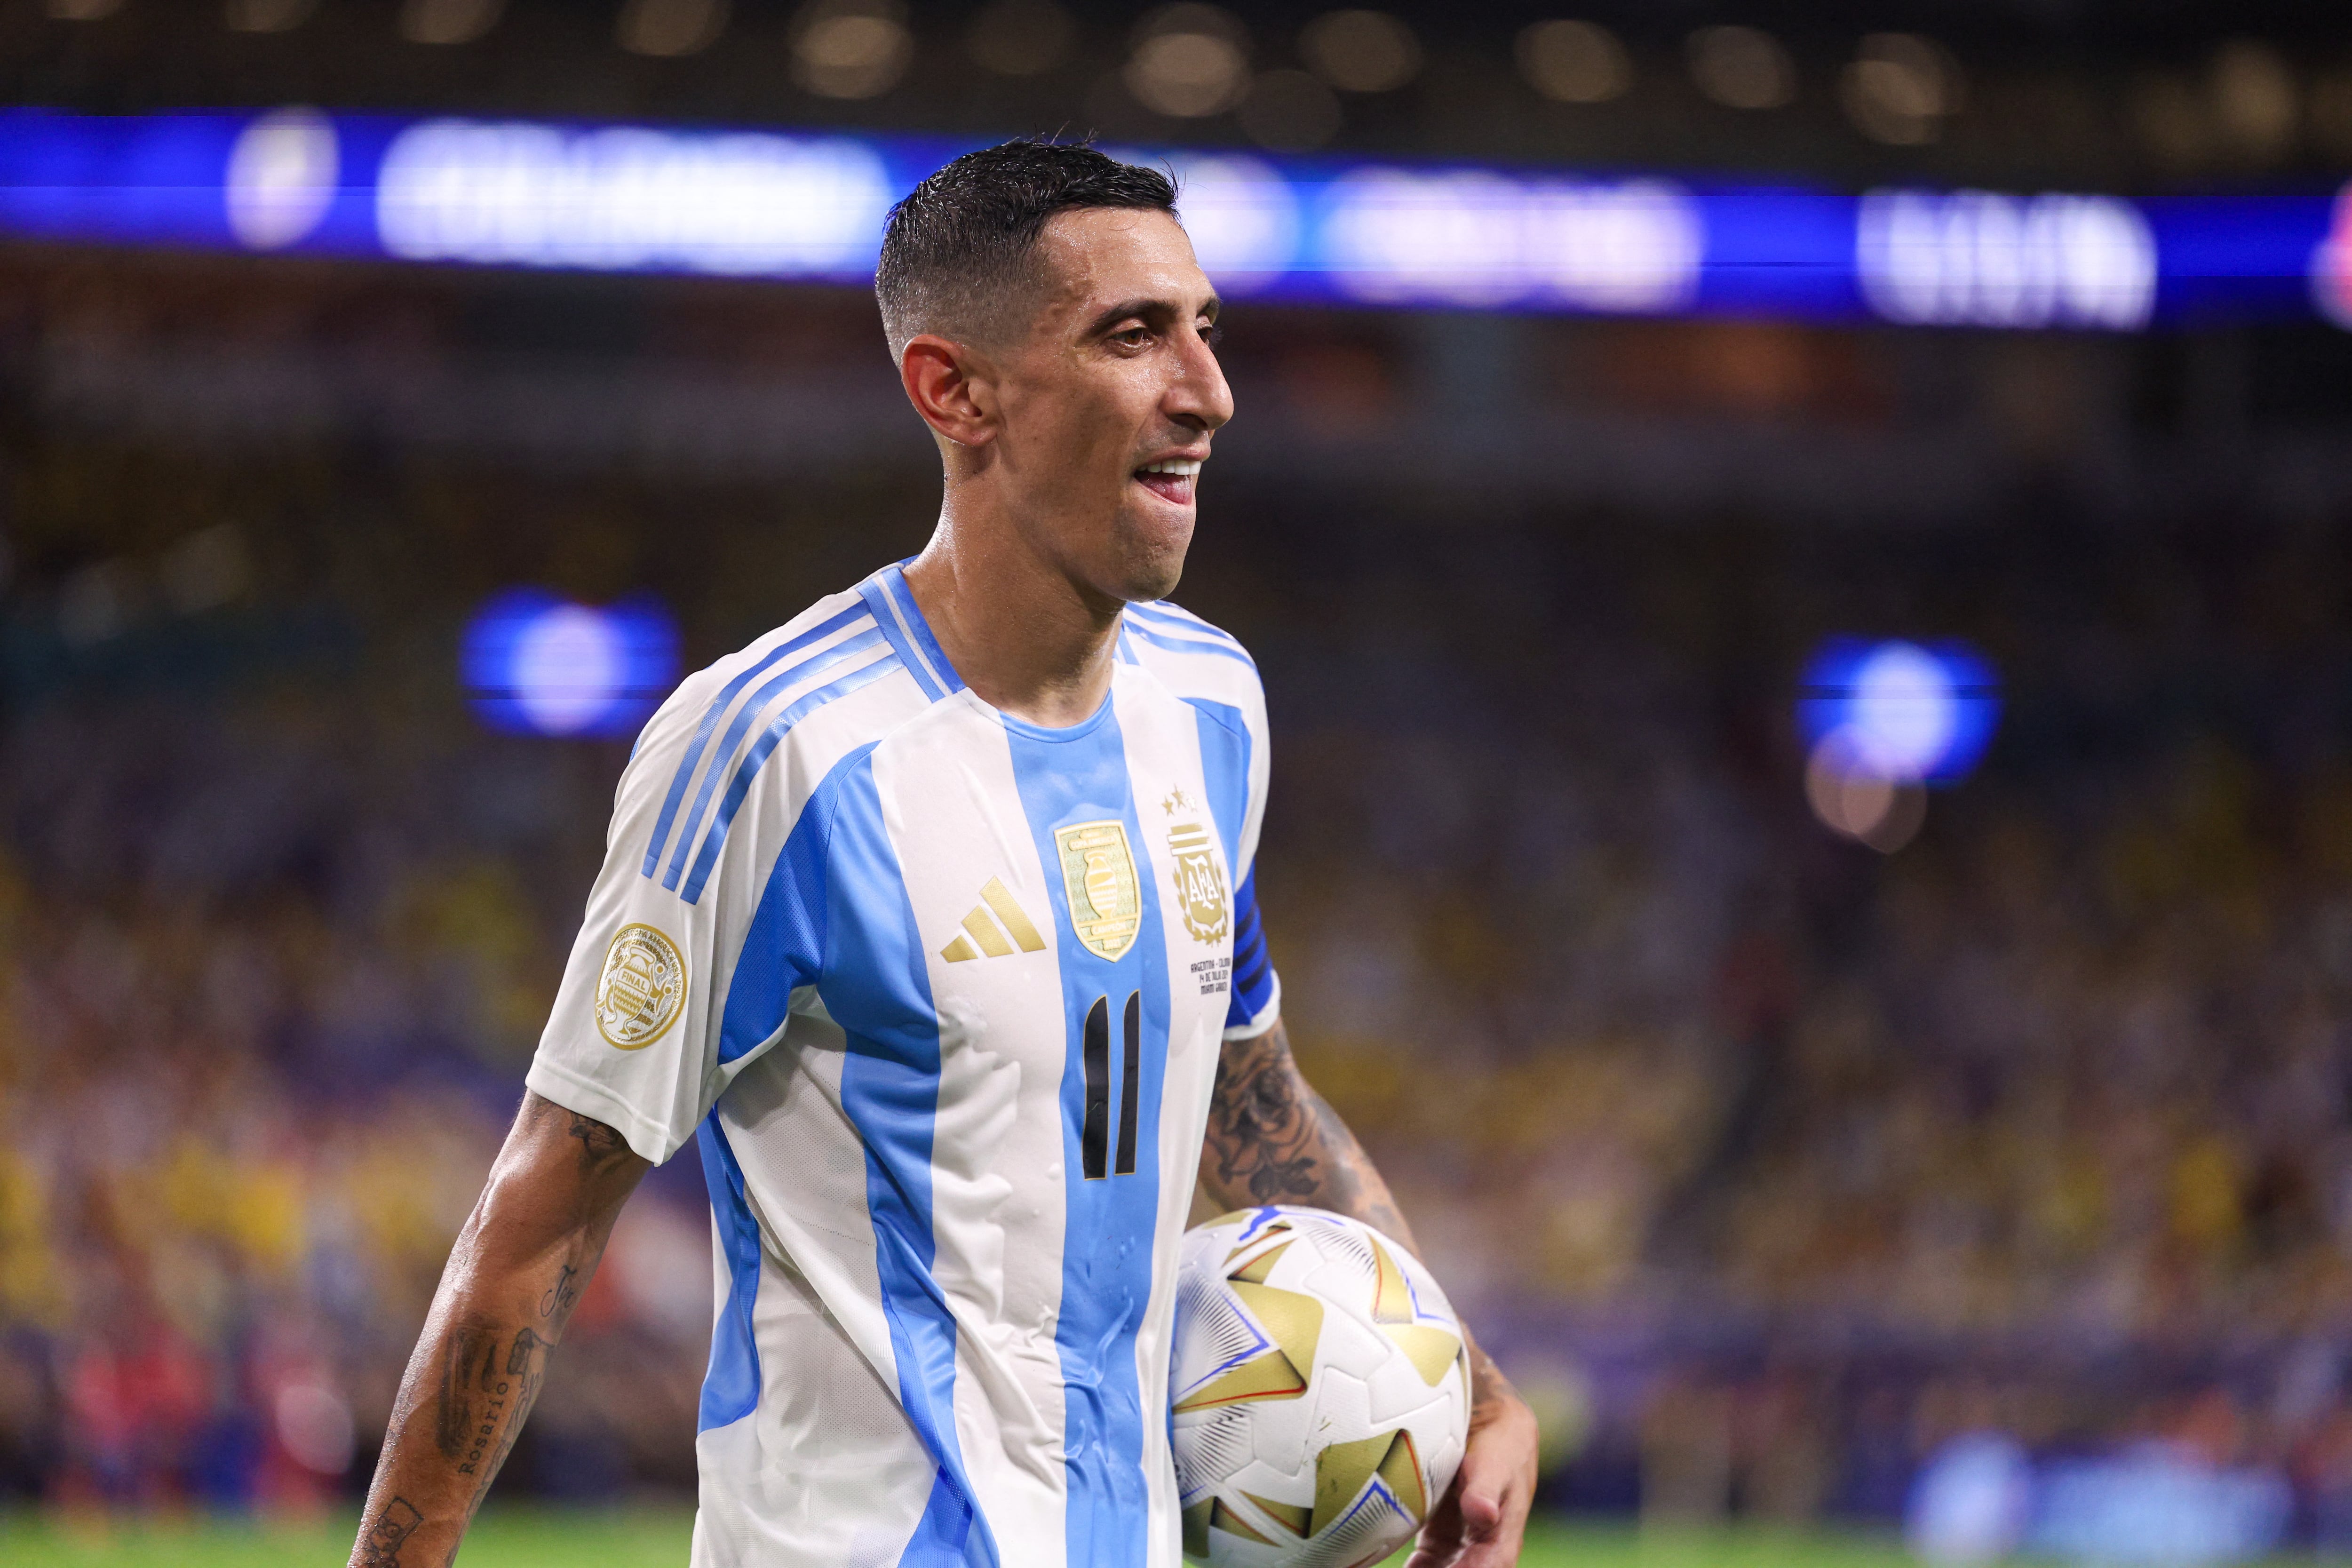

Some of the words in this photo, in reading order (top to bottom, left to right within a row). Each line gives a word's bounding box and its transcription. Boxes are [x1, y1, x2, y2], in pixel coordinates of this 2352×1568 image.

[1184, 854, 1219, 910] AFA
[621, 971, 646, 991] FINAL
[1081, 989, 1141, 1181] 11
[458, 1382, 509, 1475] Rosario
